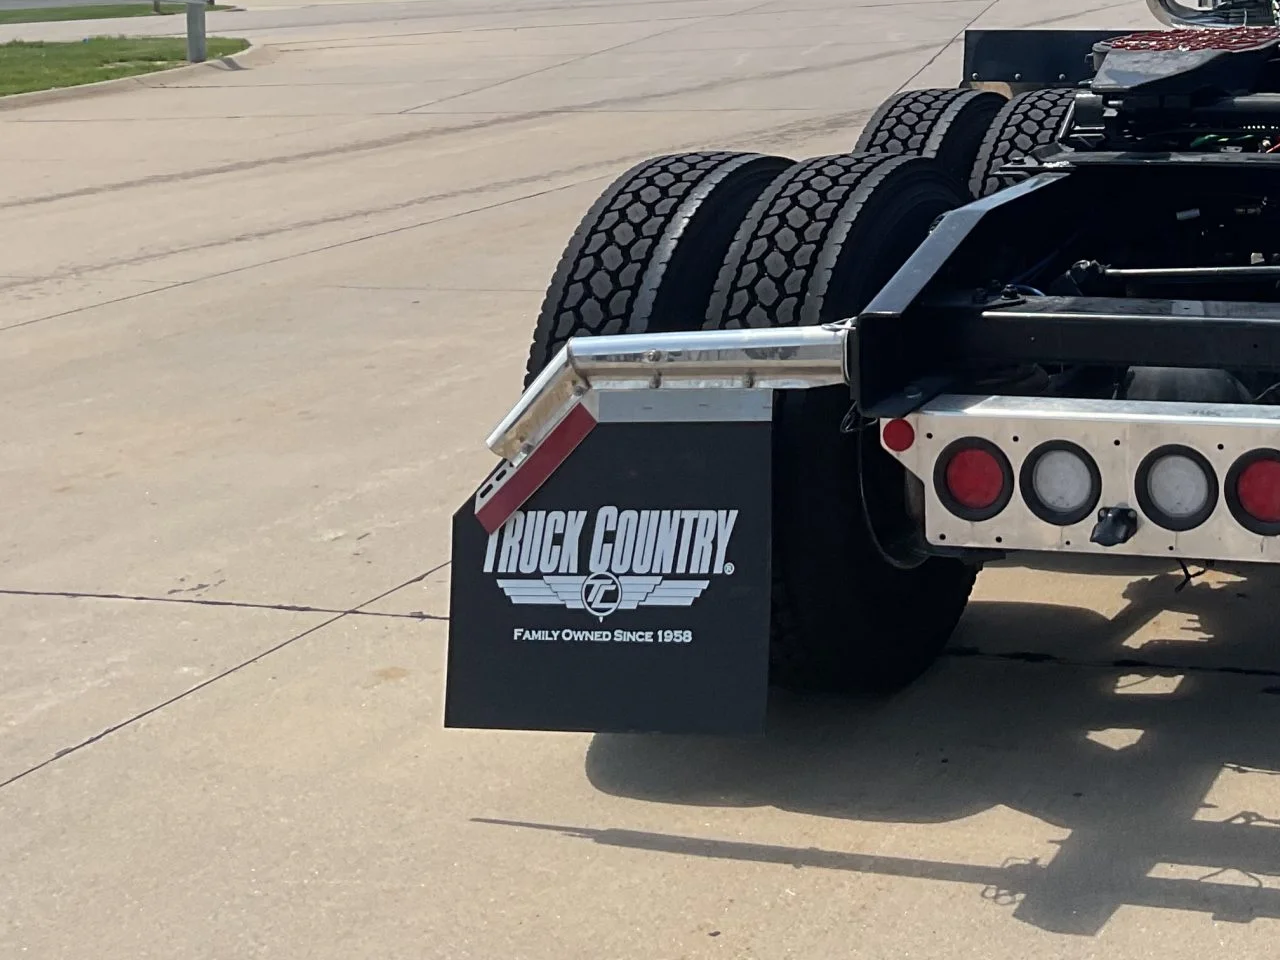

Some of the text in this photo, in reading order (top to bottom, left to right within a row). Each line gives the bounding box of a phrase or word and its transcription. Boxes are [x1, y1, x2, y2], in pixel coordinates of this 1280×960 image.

[588, 505, 739, 575] COUNTRY
[513, 628, 693, 643] FAMILY OWNED SINCE 1958
